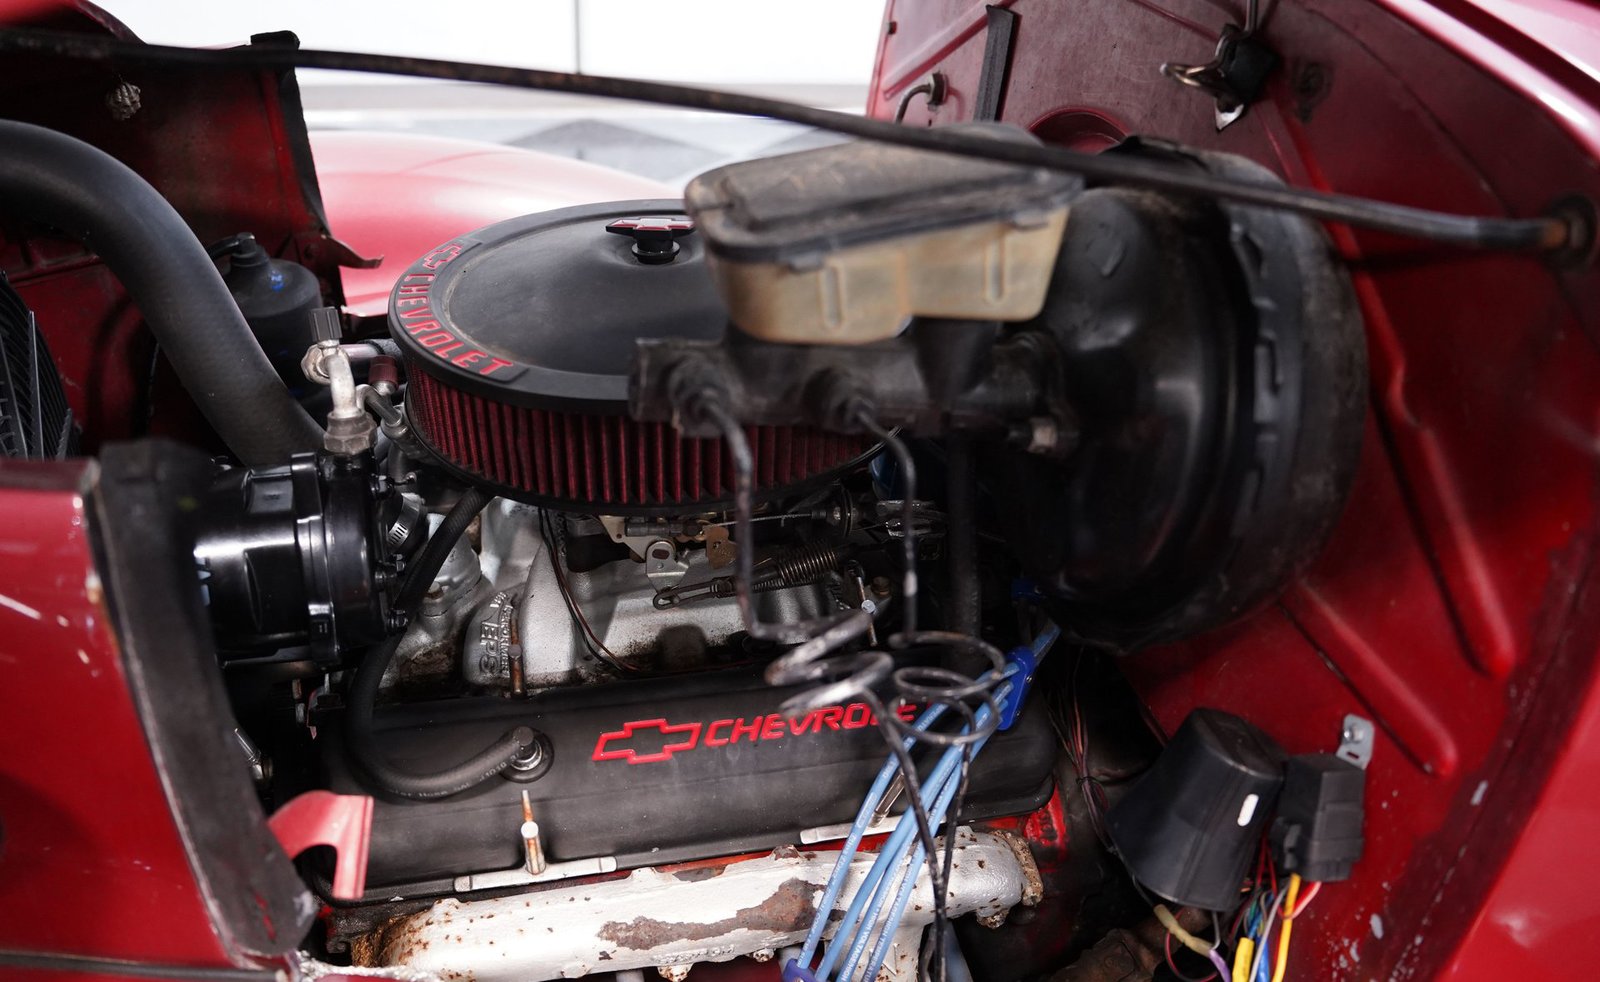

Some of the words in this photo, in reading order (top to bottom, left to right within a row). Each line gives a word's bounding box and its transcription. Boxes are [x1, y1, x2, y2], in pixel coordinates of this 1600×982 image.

[397, 272, 514, 376] CHEVROLET
[478, 621, 501, 677] EPS
[703, 702, 931, 747] CHEVROE
